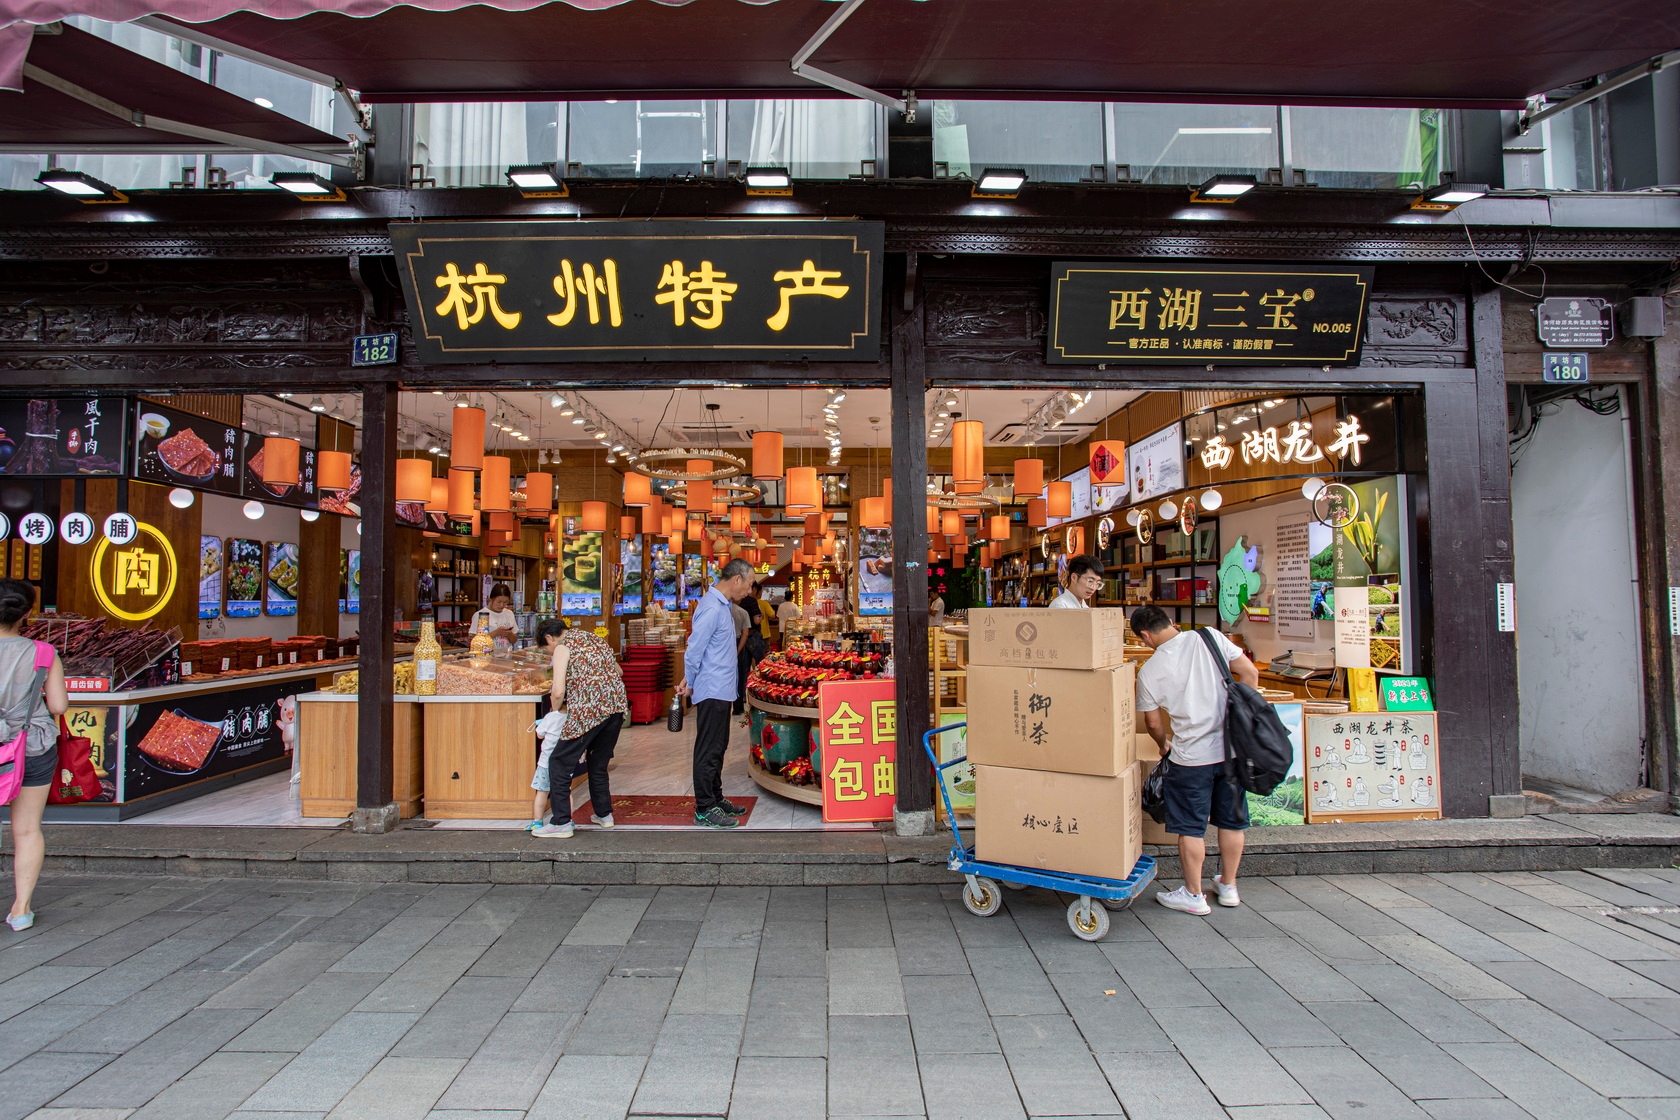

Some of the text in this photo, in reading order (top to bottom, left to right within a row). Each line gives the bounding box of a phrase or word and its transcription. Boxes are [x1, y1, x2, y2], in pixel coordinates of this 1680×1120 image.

[435, 258, 850, 331] 杭州特产
[1108, 287, 1302, 331] 西湖三宝
[1312, 322, 1352, 334] NO.005
[362, 345, 389, 361] 182
[1129, 338, 1169, 349] 官方正品
[1182, 338, 1223, 350] 认准商标
[1550, 356, 1581, 364] 河坊街
[1552, 366, 1580, 379] 180
[1200, 413, 1371, 469] 西湖龙井
[25, 518, 129, 539] 烤肉脯
[113, 547, 160, 596] 肉
[826, 701, 896, 746] 全国
[1028, 692, 1052, 746] 御茶
[1332, 719, 1414, 736] 西湖龙井茶
